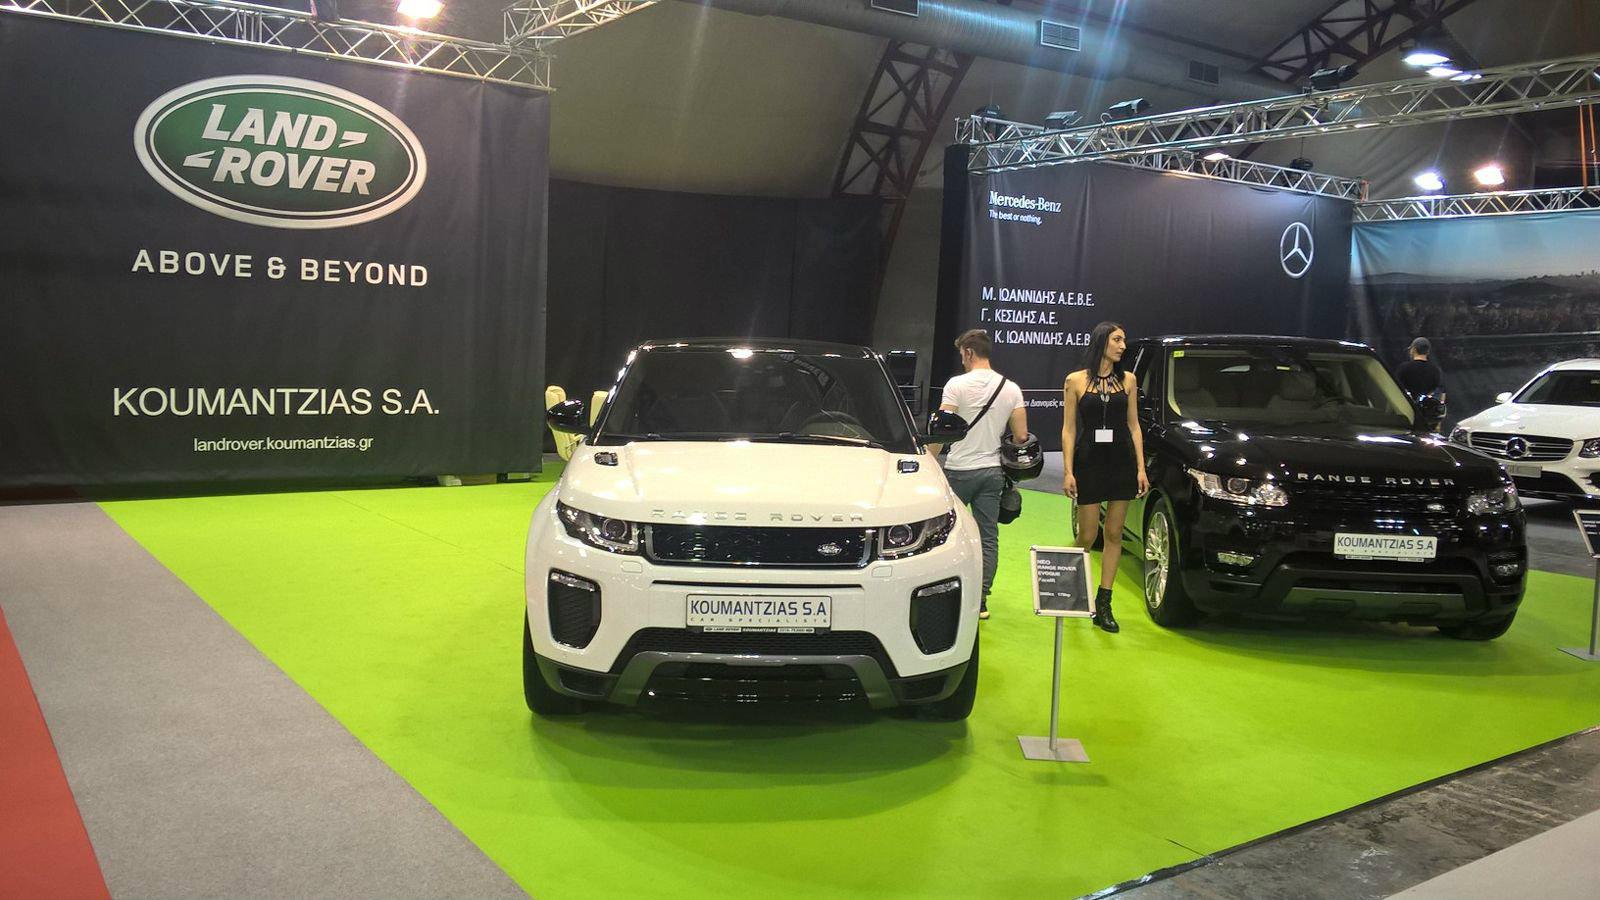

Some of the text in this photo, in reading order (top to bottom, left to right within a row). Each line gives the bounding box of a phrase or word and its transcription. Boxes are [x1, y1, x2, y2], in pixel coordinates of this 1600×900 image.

[202, 103, 337, 151] LAND
[212, 147, 376, 195] ROVER
[989, 190, 1062, 213] Mercedes-Benz
[989, 209, 998, 219] The
[999, 211, 1012, 221] best
[131, 249, 428, 287] ABOVE & BEYOND
[982, 286, 997, 301] Μ.
[999, 287, 1056, 304] ΙΩΑΝΝΙΔΗΣ
[981, 308, 991, 322] Γ.
[995, 308, 1037, 324] ΚΕΣΙΔΗΣ
[1007, 330, 1063, 345] ΙΩΑΝΝΙΔΗΣ
[113, 387, 440, 416] KOUMANTZIAS S.A.
[193, 436, 374, 452] landrover.koumantzias.gr
[1297, 472, 1455, 486] RANGE ROVER
[770, 512, 864, 522] ROVER
[1337, 536, 1413, 550] KOUMANTZIAS
[691, 600, 797, 616] KOUMANTZIAS
